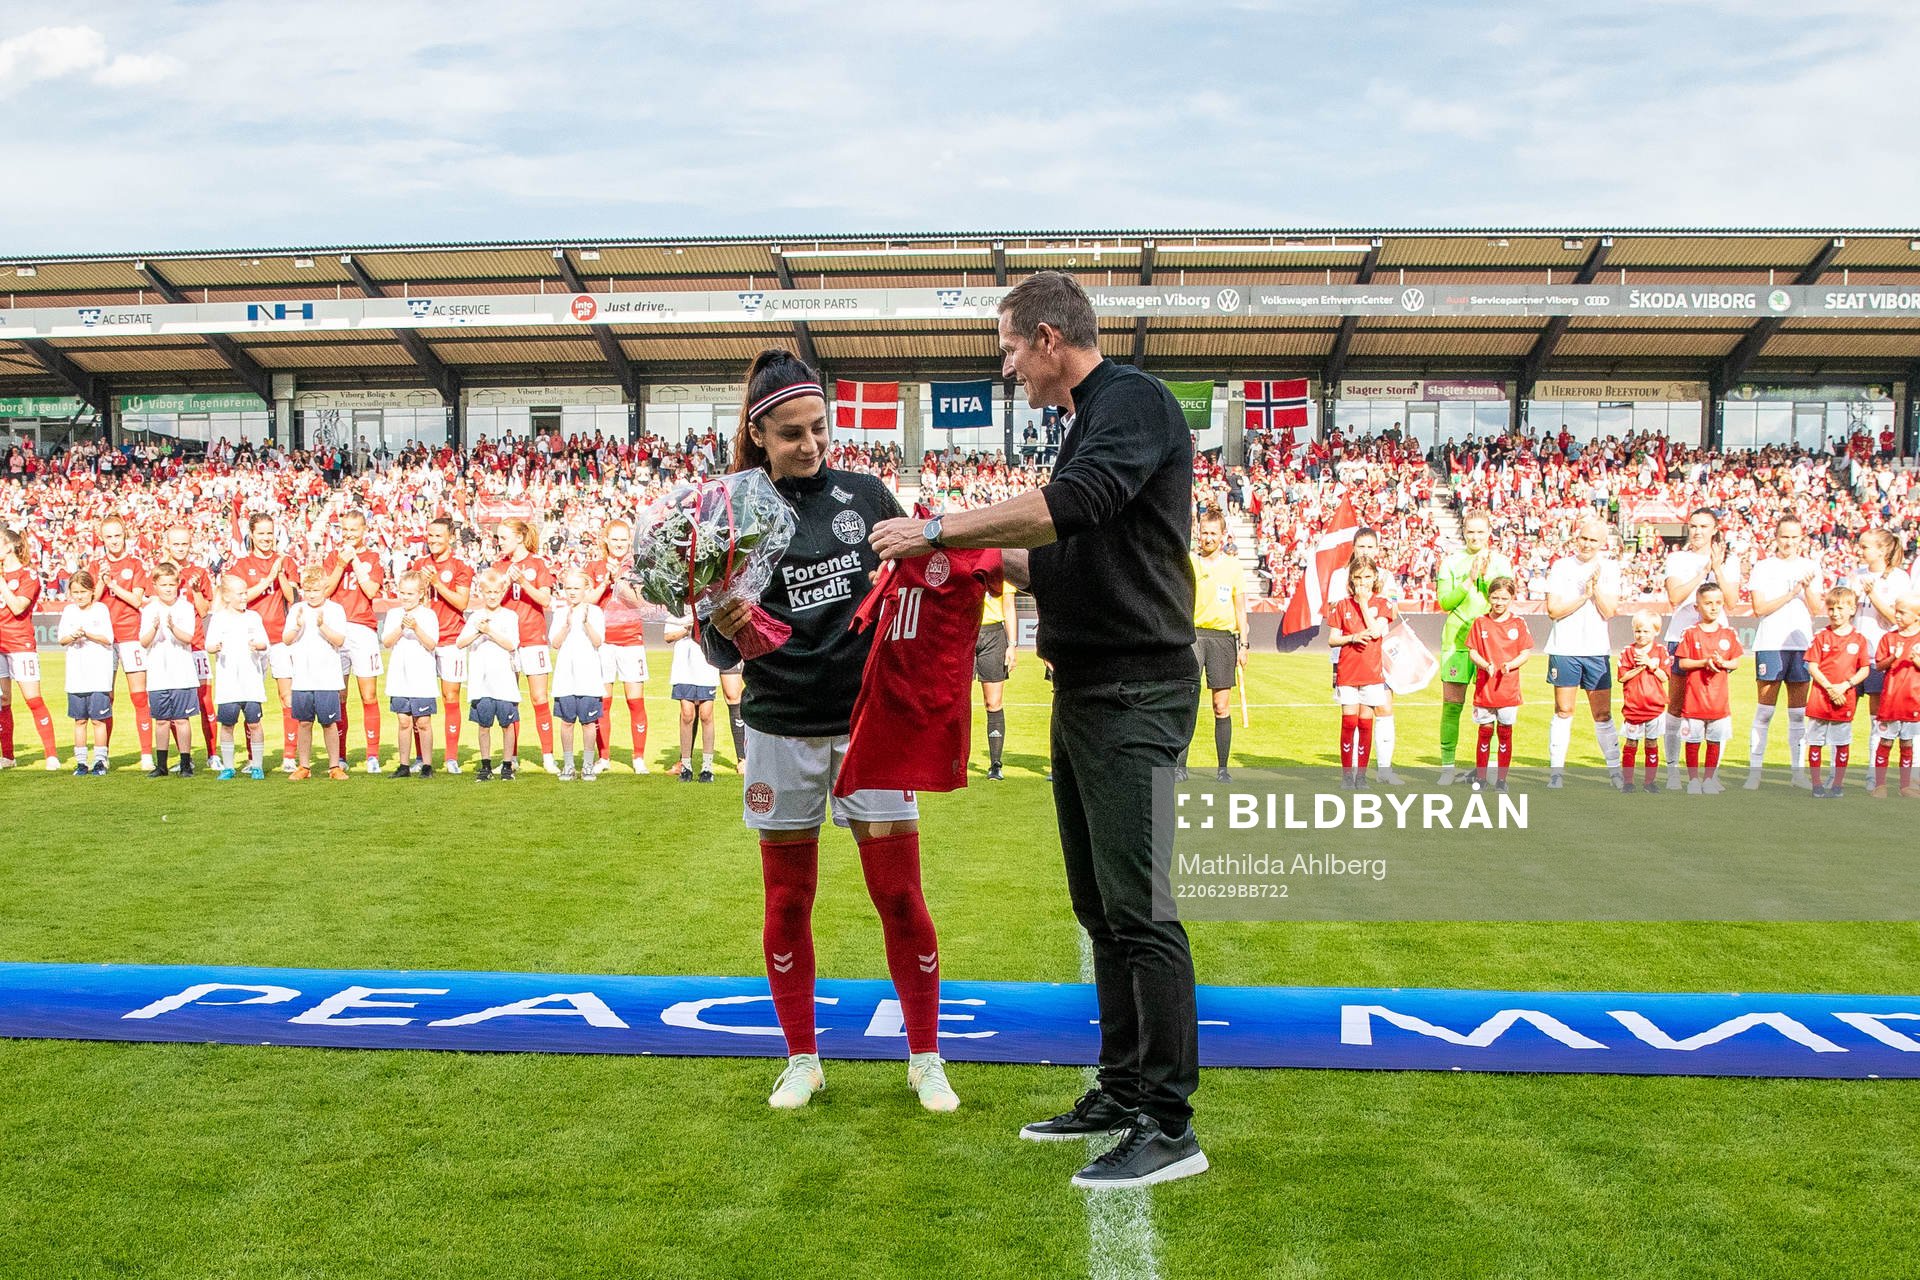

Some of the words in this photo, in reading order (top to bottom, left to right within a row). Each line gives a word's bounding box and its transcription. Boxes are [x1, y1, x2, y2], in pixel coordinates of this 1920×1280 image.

[764, 299, 779, 310] AC
[782, 299, 821, 309] MOTOR
[824, 298, 858, 309] PARTS
[963, 296, 977, 307] AC
[980, 296, 1001, 307] GRO
[1089, 294, 1162, 309] olkswagen
[1164, 293, 1211, 309] Viborg
[1261, 295, 1319, 307] Volkswagen
[1320, 294, 1394, 305] ErhvervsCenter
[1470, 295, 1545, 306] Servicepartner
[1545, 295, 1579, 306] Viborg
[1629, 289, 1689, 309] ŠKODA
[1692, 292, 1756, 309] VIBORG
[1824, 292, 1867, 309] SEAT
[432, 305, 446, 316] AC
[449, 304, 491, 316] SERVICE
[604, 301, 631, 313] Just
[634, 301, 674, 312] drive...
[102, 314, 115, 325] AC
[118, 313, 153, 324] ESTATE
[577, 309, 590, 318] pit
[517, 388, 543, 396] Viborg
[1346, 385, 1383, 397] Slagter
[1386, 385, 1417, 395] Storm
[1427, 385, 1466, 397] Slagter
[1468, 385, 1499, 396] Storm
[1541, 385, 1549, 397] A
[1551, 385, 1602, 397] HEREFORD
[1605, 385, 1662, 397] BEEFSTOUW
[148, 399, 185, 411] Viborg
[940, 396, 984, 413] FIFA
[1180, 400, 1207, 409] SPECT
[840, 520, 860, 533] DBU
[782, 551, 862, 585] Forenet
[343, 571, 358, 591] 12
[787, 576, 851, 609] Kredit
[134, 649, 143, 667] 6
[538, 651, 546, 668] 8
[752, 792, 769, 803] DBU
